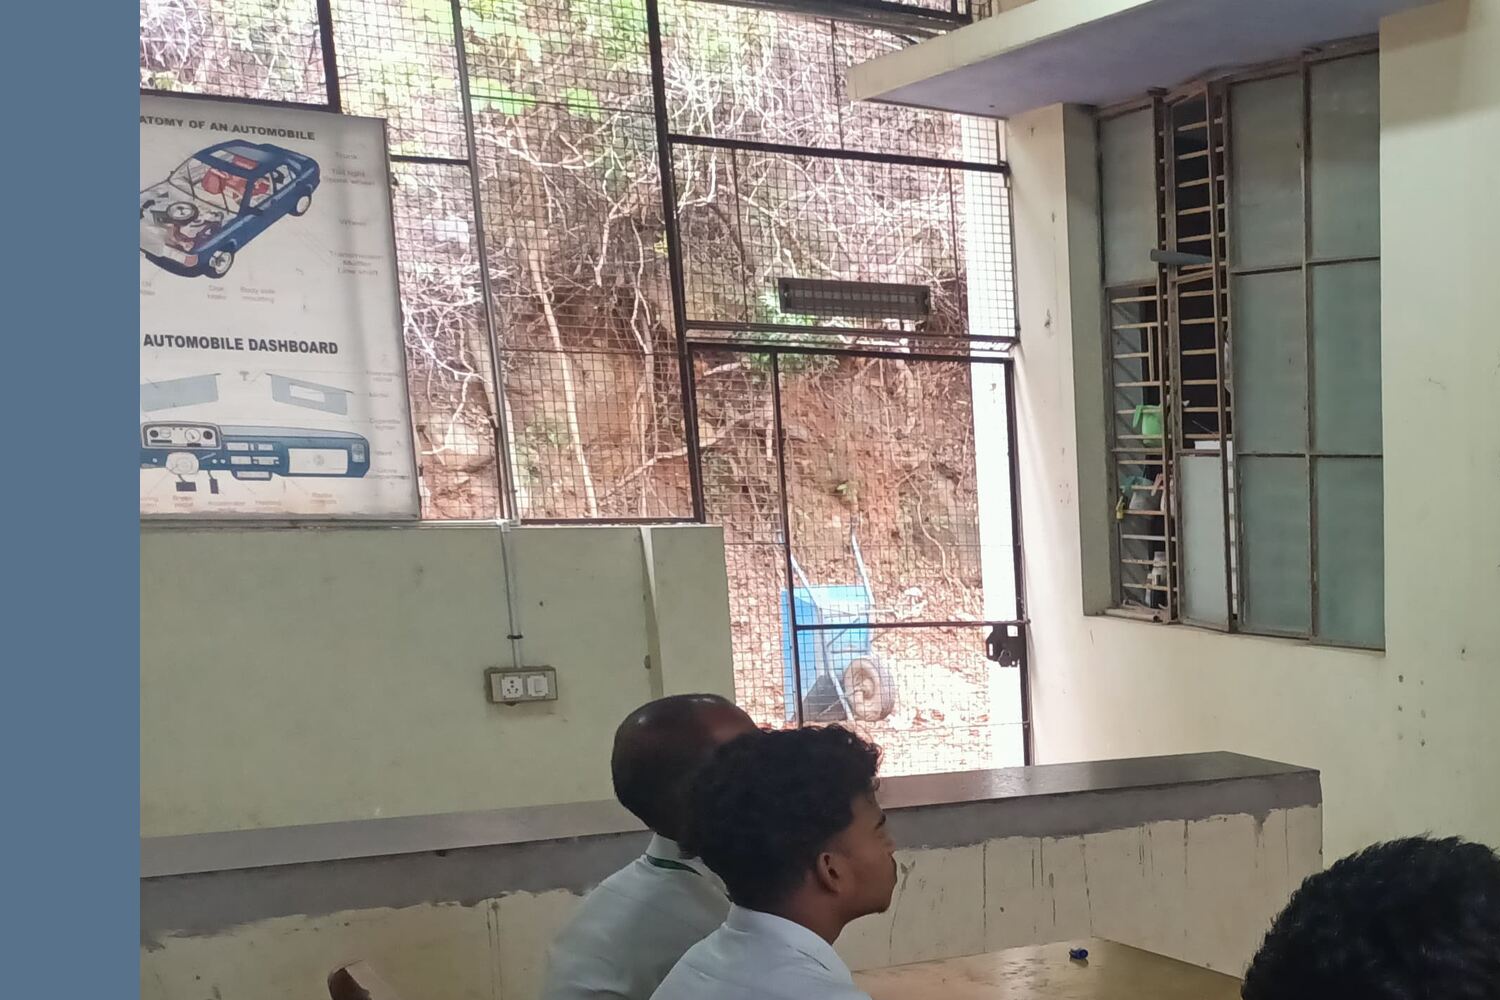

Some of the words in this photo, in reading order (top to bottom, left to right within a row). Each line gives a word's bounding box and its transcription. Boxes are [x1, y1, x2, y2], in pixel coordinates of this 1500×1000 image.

[189, 120, 205, 130] OF
[210, 122, 228, 132] AN
[231, 124, 316, 141] AUTOMOBILE
[143, 333, 245, 351] AUTOMOBILE
[248, 338, 339, 355] DASHBOARD
